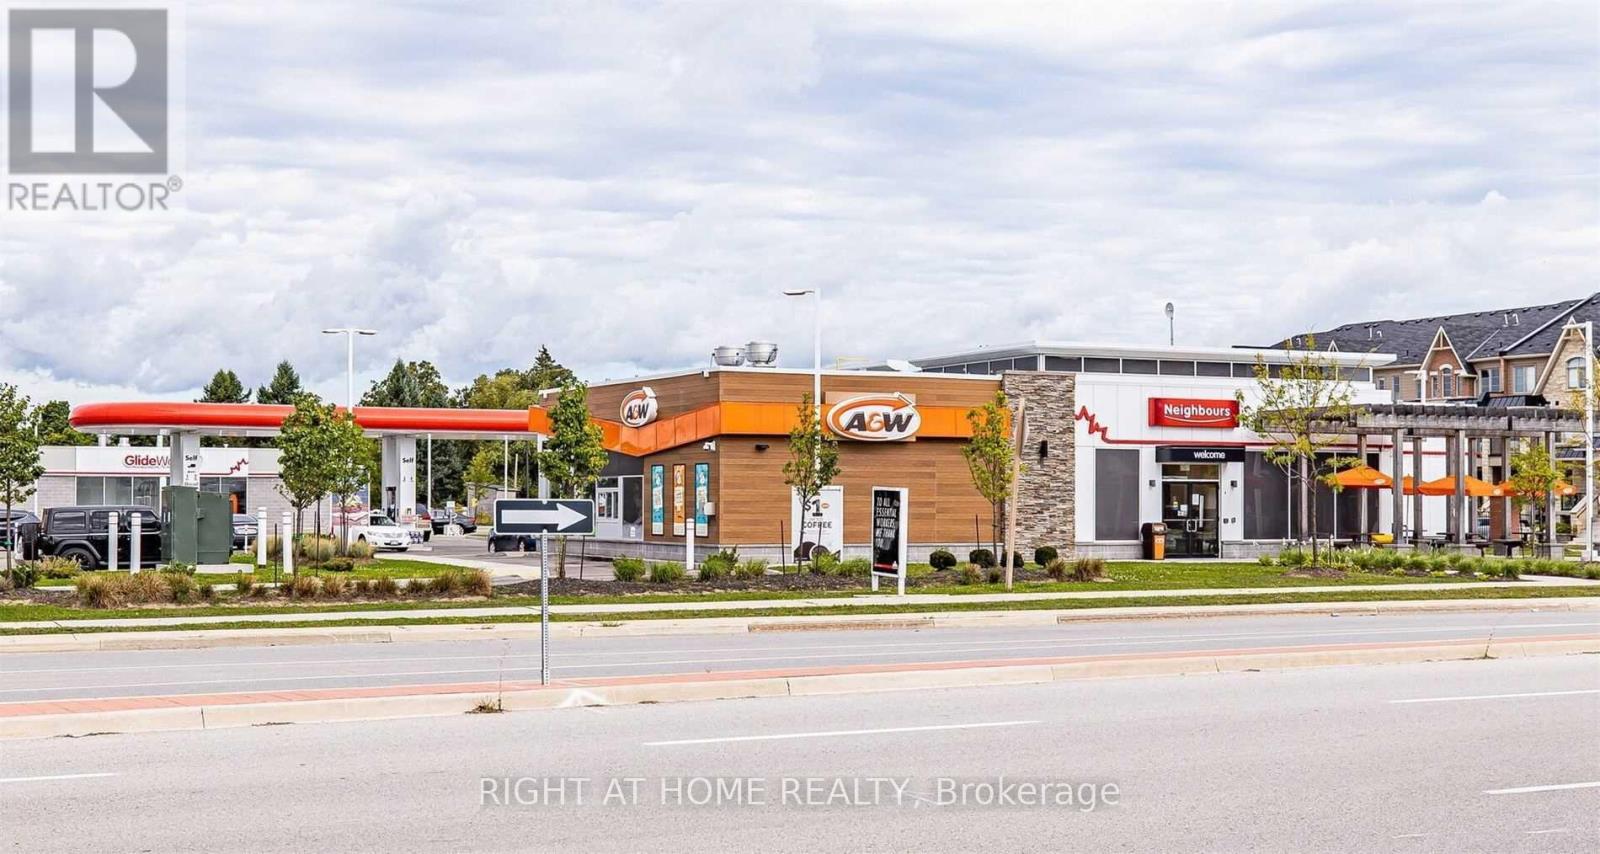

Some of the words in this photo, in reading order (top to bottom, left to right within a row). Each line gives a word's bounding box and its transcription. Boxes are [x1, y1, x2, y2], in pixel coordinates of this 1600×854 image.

[626, 402, 649, 420] A&W
[1164, 404, 1231, 418] Neighbours
[844, 411, 914, 433] A&W
[1193, 450, 1226, 459] welcome
[876, 507, 897, 518] ESSENTIAL
[875, 528, 882, 538] WE
[883, 528, 896, 539] THANK
